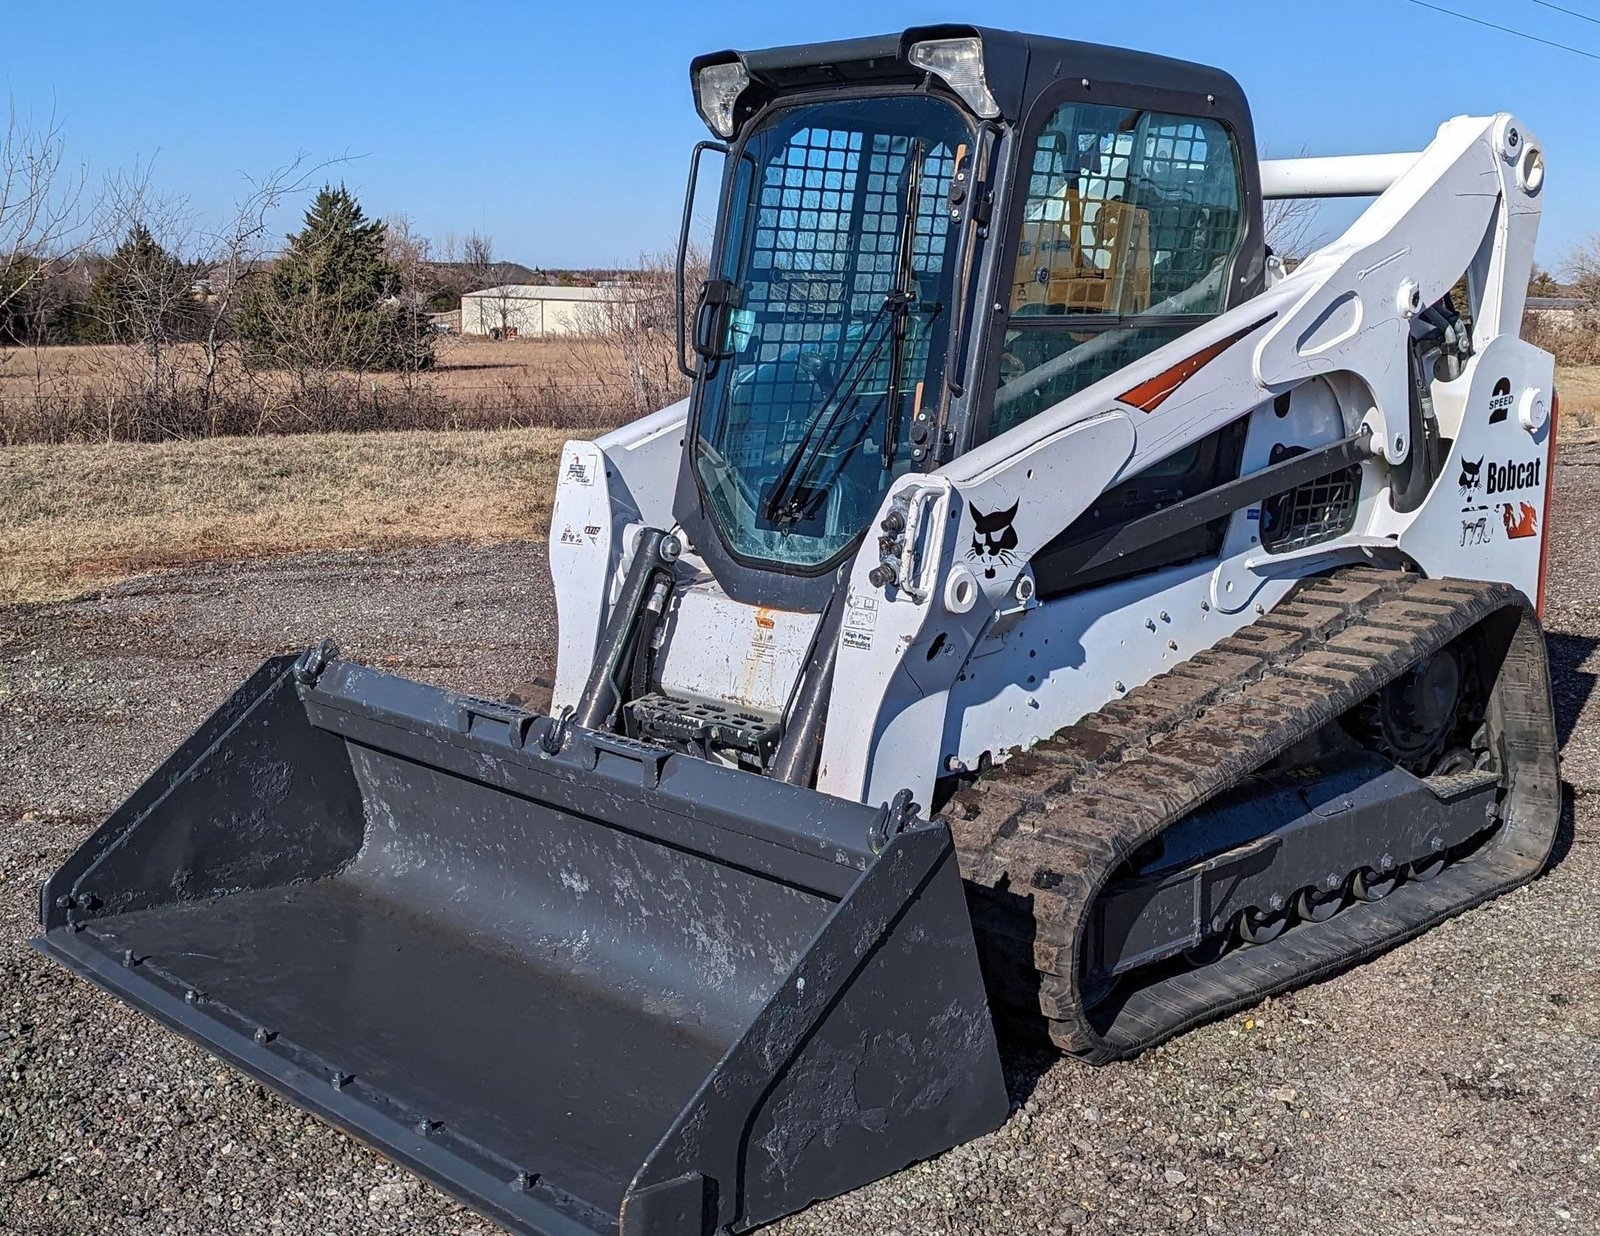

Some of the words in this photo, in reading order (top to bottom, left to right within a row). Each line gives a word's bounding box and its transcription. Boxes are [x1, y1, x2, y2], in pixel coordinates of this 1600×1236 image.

[1489, 395, 1514, 410] SPEED
[1486, 458, 1541, 494] Bobcat
[844, 637, 871, 647] Hydraulics
